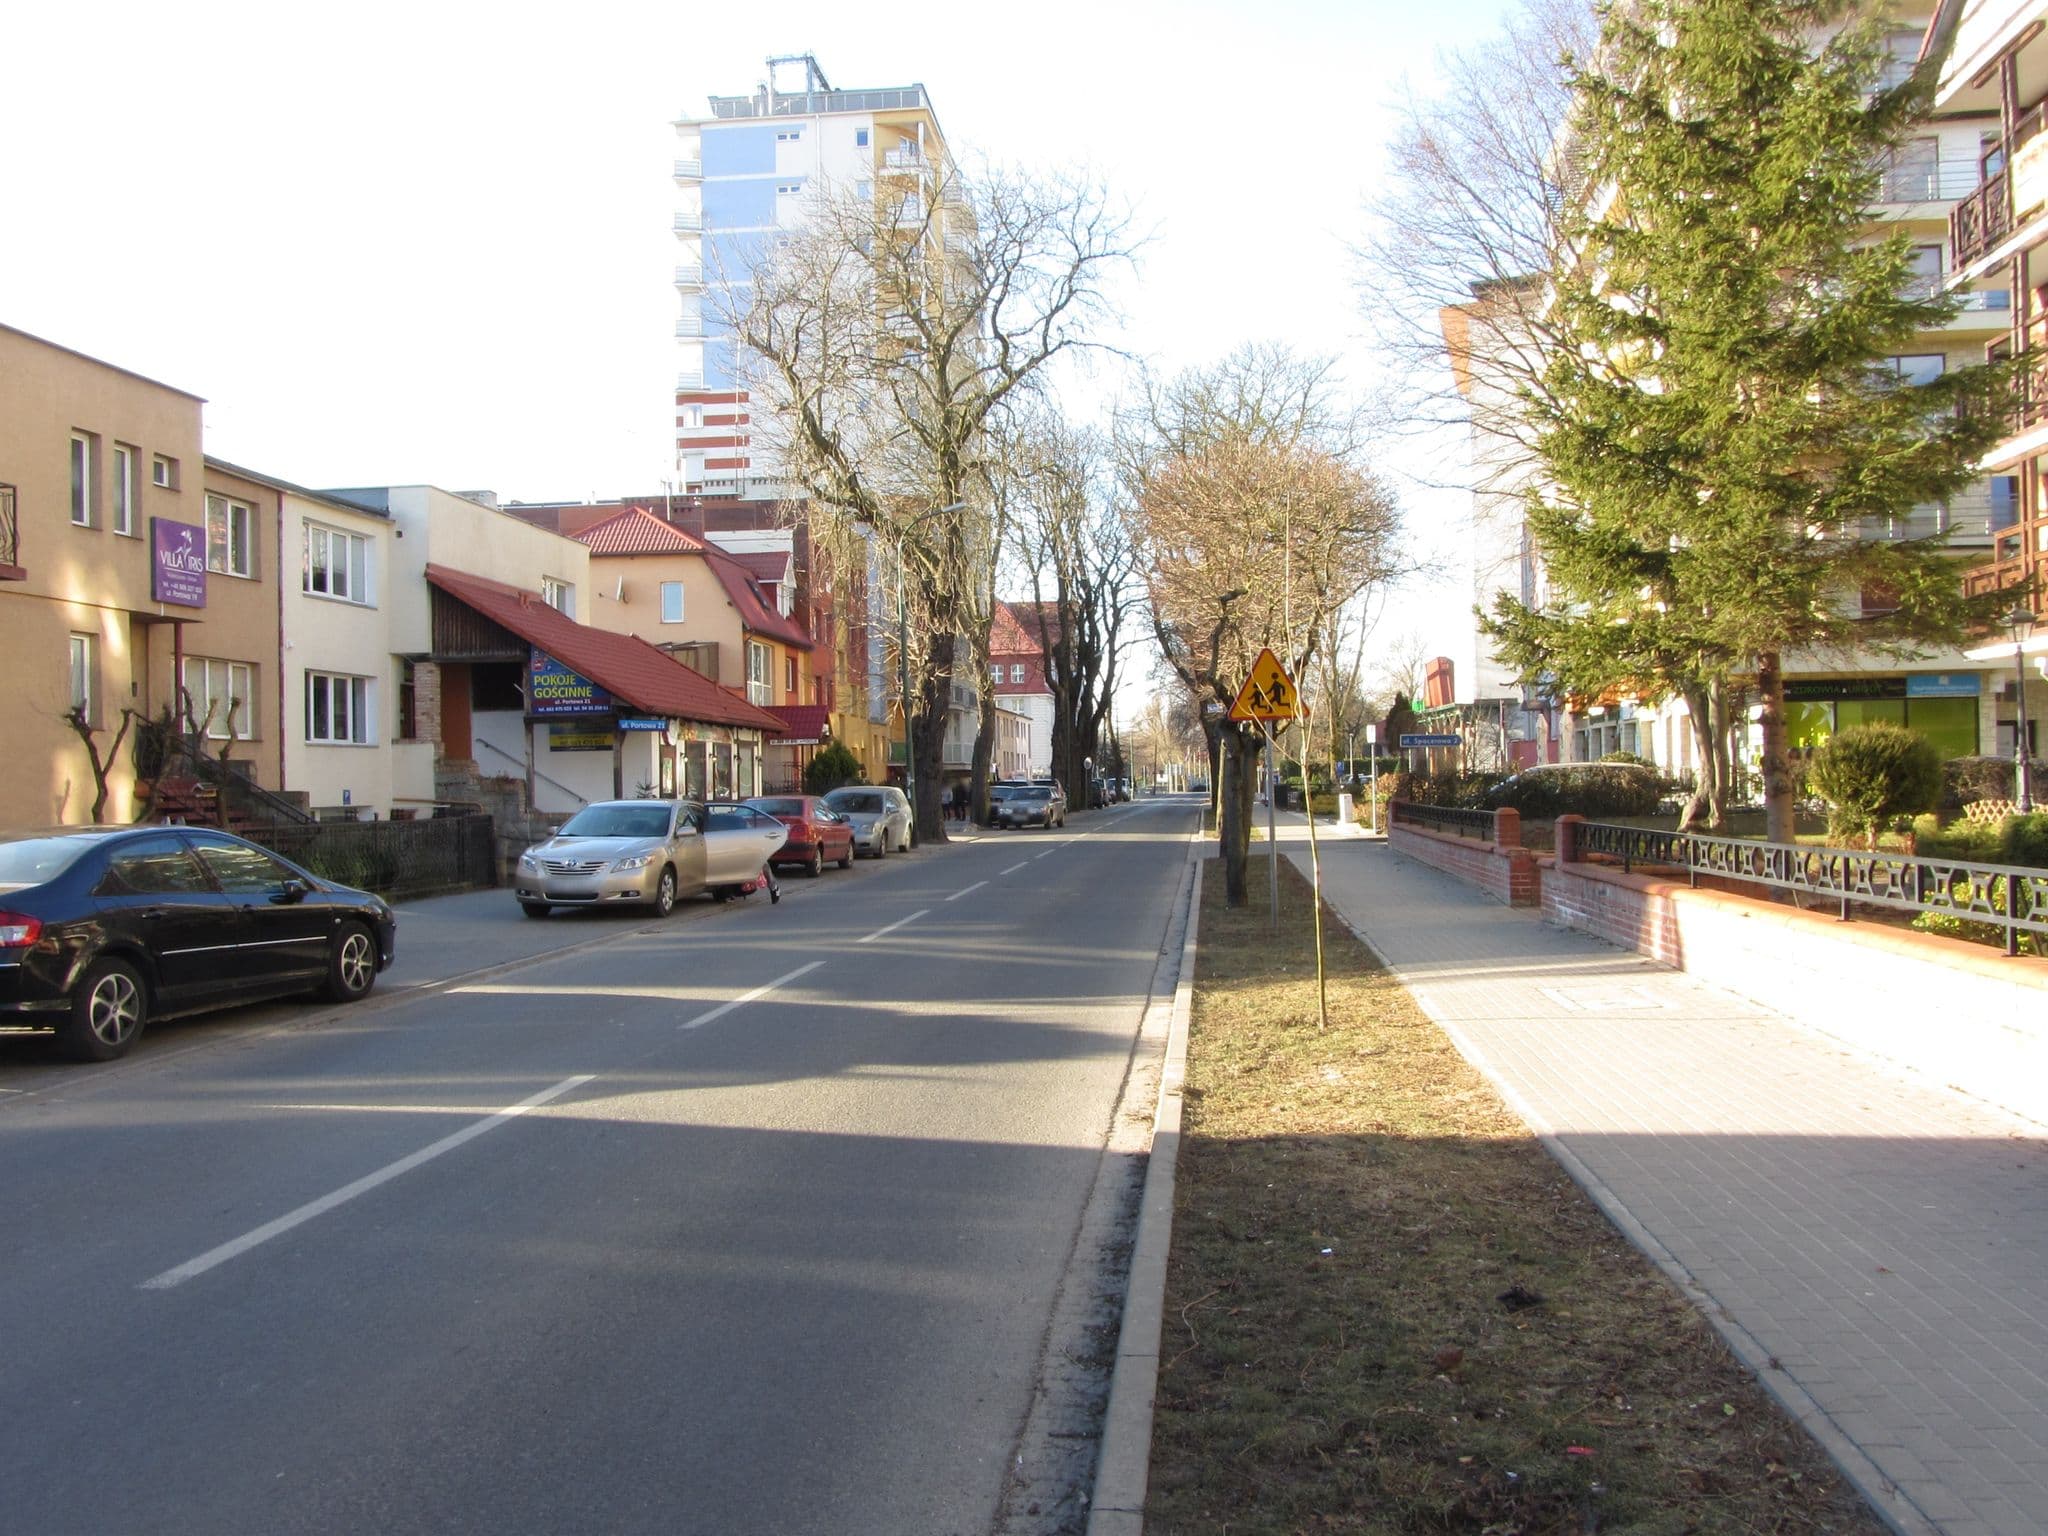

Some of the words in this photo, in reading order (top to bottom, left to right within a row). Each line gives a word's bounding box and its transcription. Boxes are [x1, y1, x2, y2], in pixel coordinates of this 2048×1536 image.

[160, 550, 184, 569] VILLA
[188, 555, 204, 572] IRIS
[172, 590, 192, 600] Portowa
[534, 674, 576, 686] POKOJE
[534, 685, 592, 699] GOŚCINNE
[621, 721, 629, 729] ul.
[630, 721, 657, 729] Portowa
[1414, 737, 1451, 746] Spacerowa
